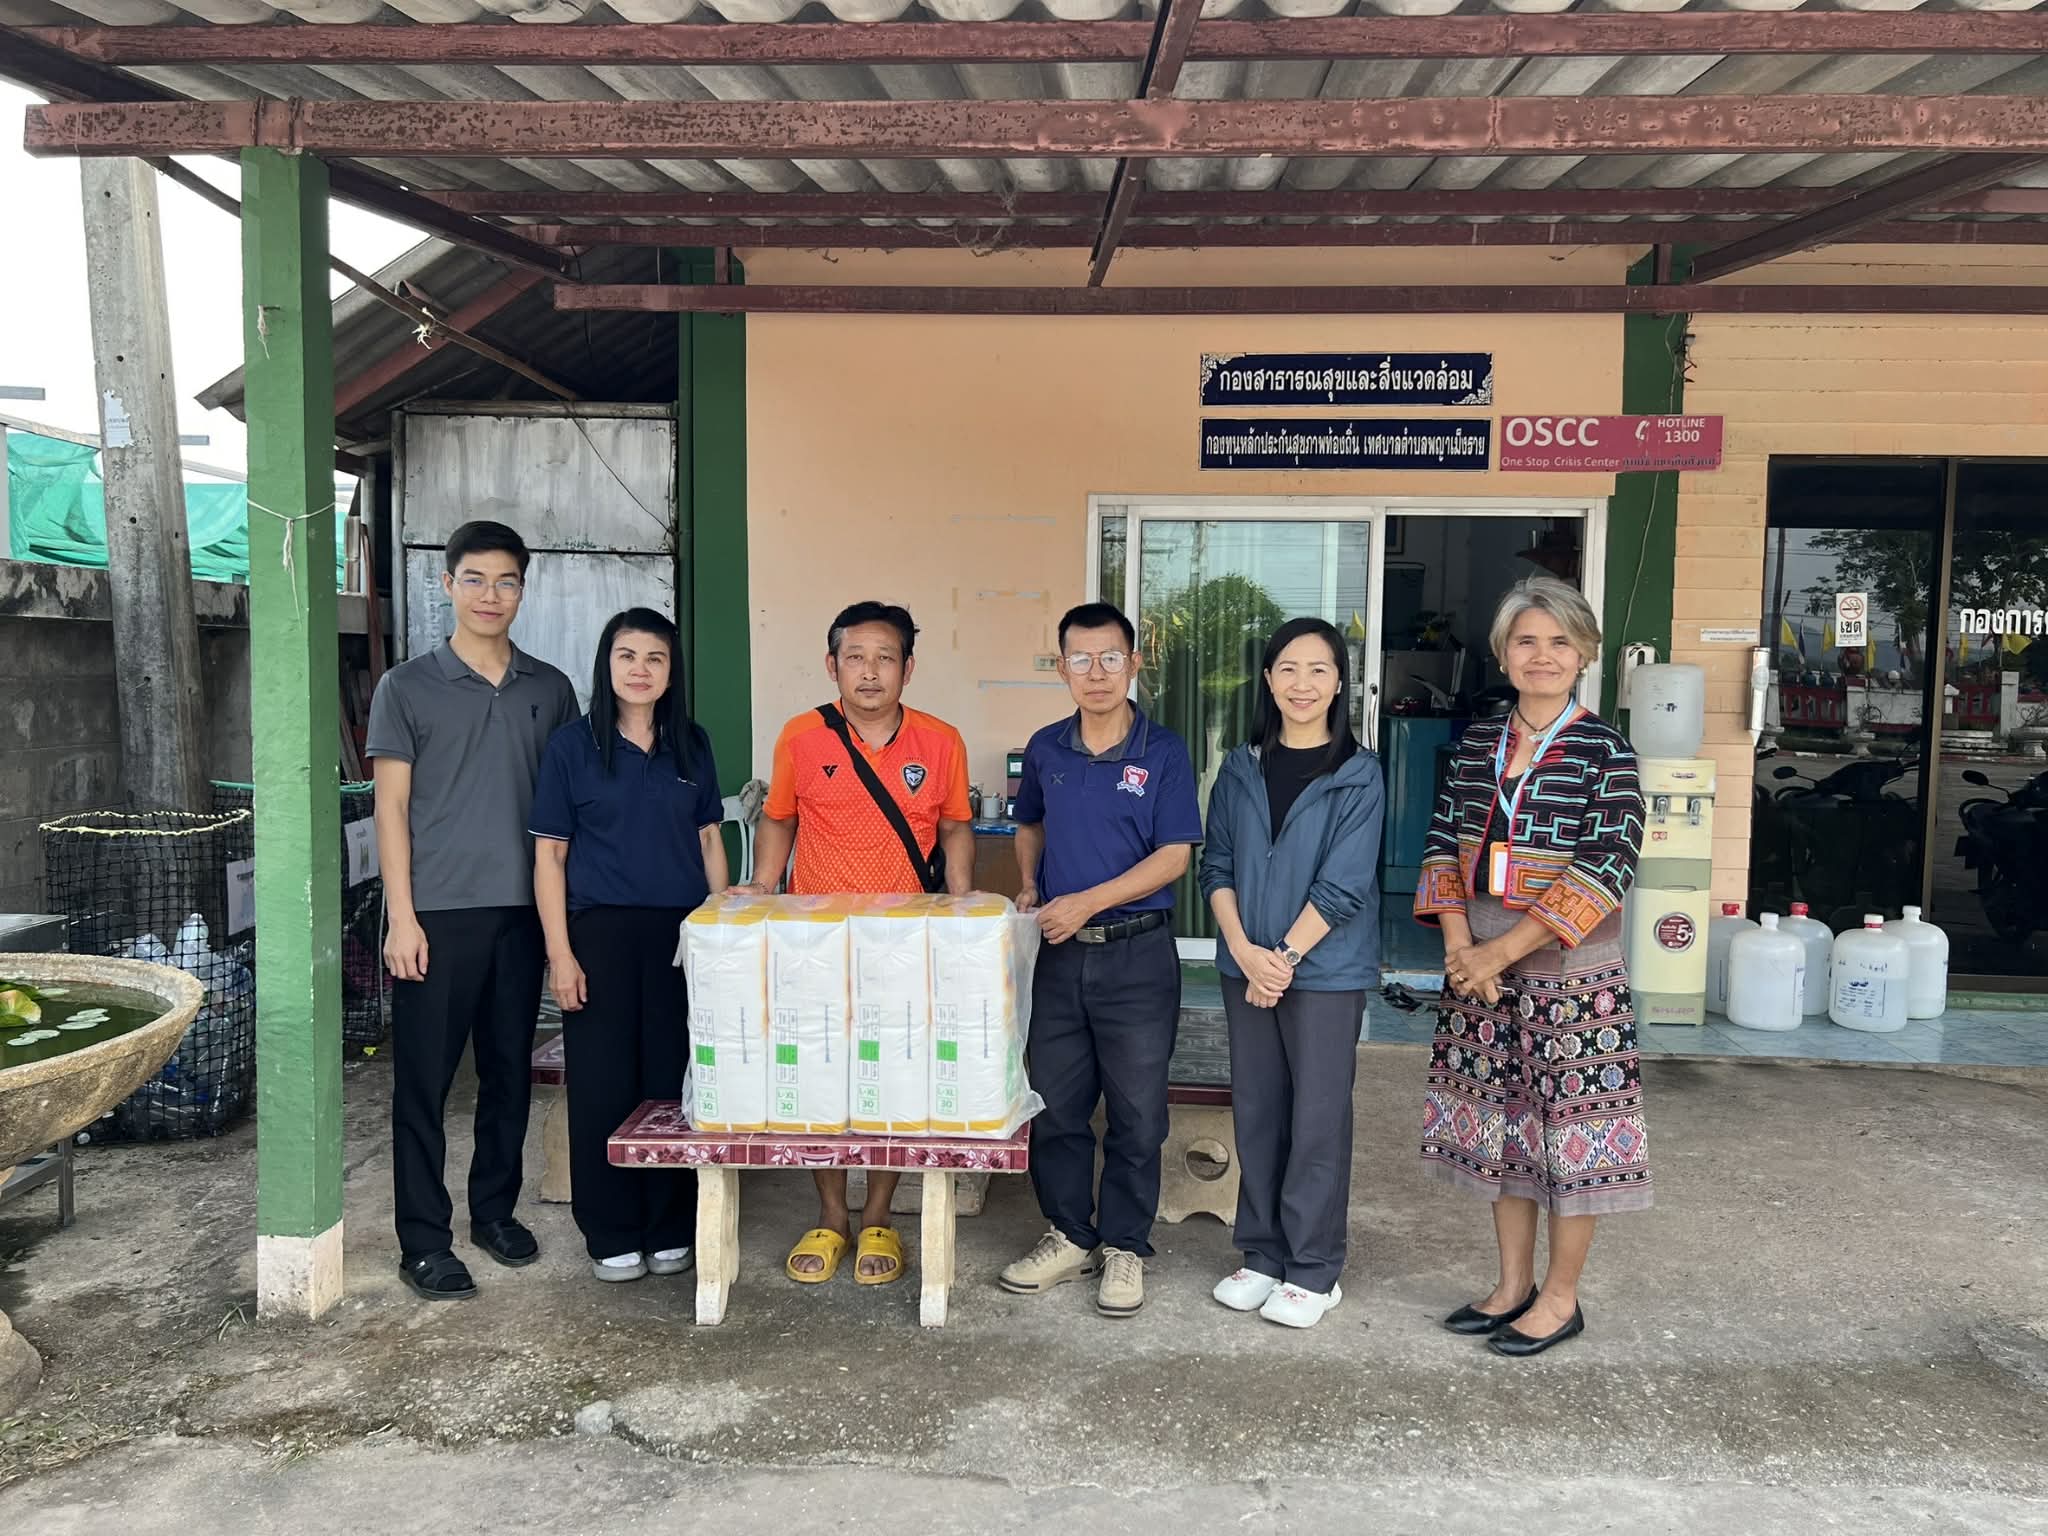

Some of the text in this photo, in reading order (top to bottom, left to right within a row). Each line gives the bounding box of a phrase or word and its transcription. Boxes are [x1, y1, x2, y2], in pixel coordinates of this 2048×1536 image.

[1219, 356, 1473, 402] กองสาธารณสุขและสิ่งแวดล้อม
[1505, 417, 1600, 447] OSCC
[1657, 418, 1705, 428] HOTLINE
[1206, 422, 1485, 465] กองทุนหลักประกันสุขภาพท้องถิ่น เทศบาลตำบลพญาเม็งราย
[1663, 430, 1700, 443] 1300
[1501, 457, 1523, 467] One
[1525, 457, 1550, 468] Stop
[1554, 456, 1582, 467] Crisis
[1584, 457, 1620, 467] Center
[1840, 620, 1862, 633] เขต
[1960, 608, 2048, 635] กองการ
